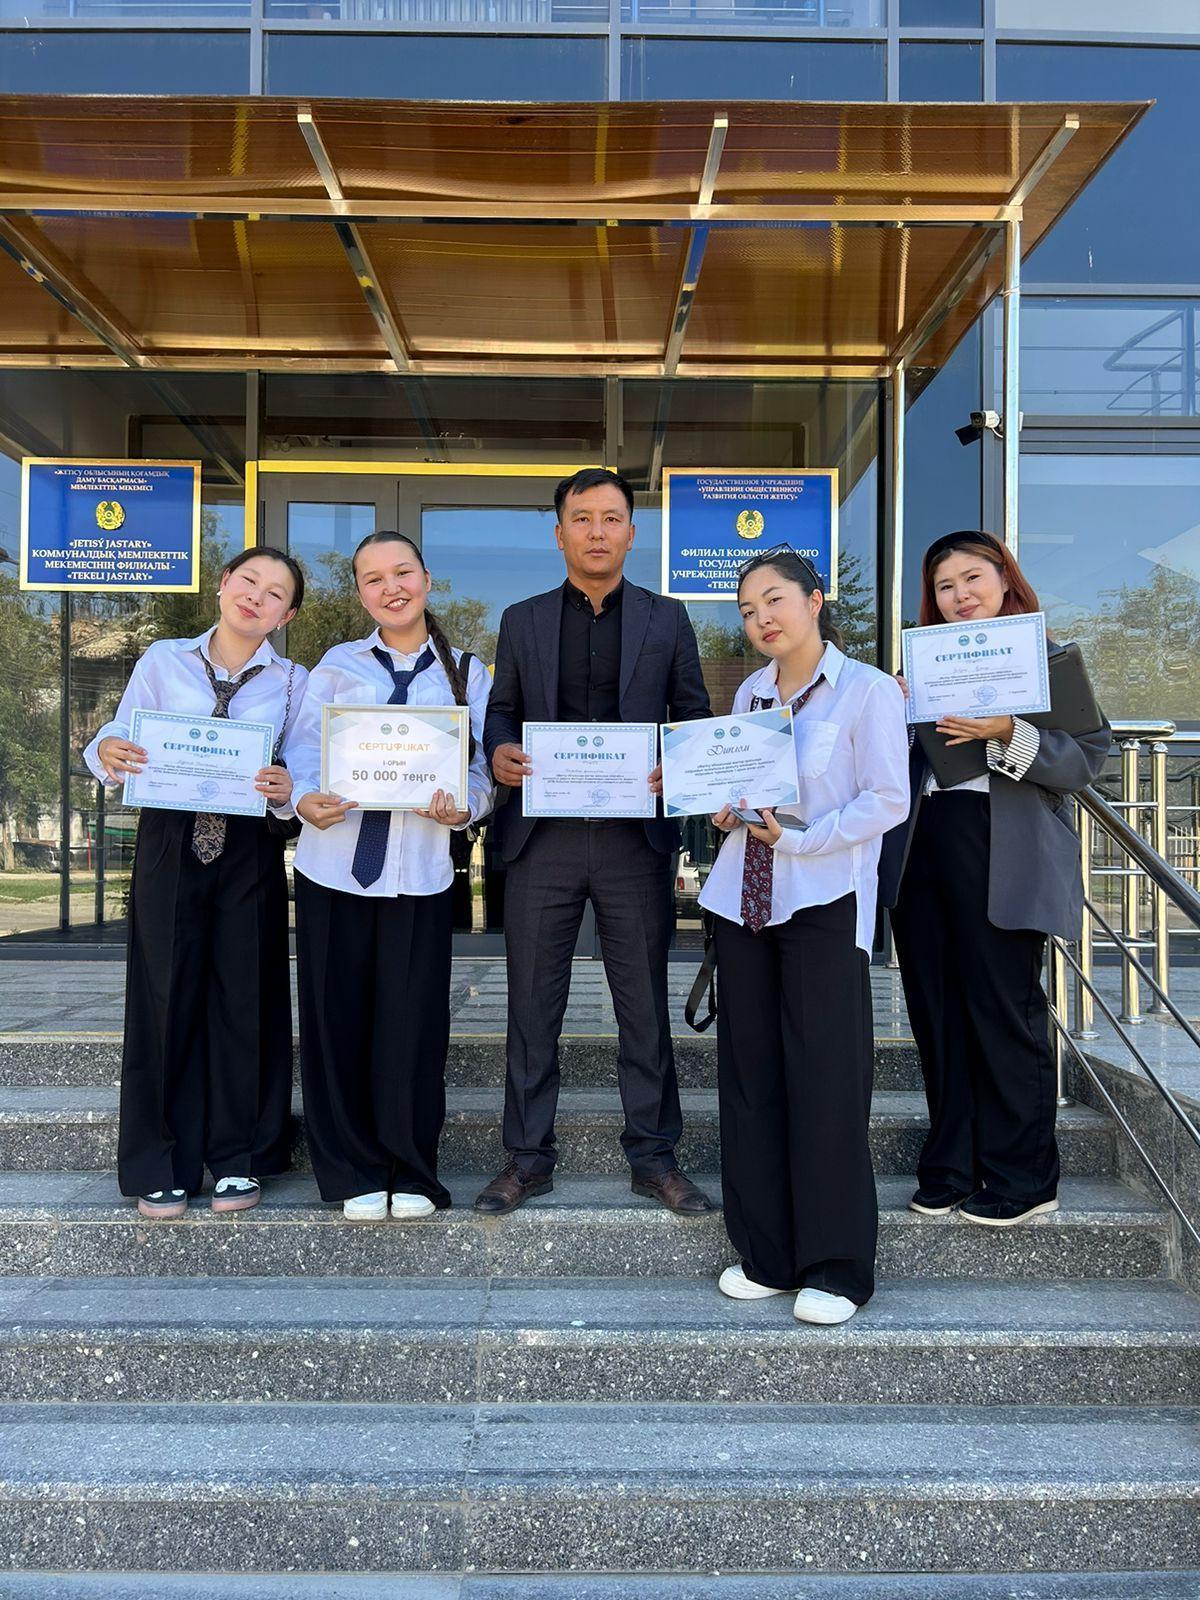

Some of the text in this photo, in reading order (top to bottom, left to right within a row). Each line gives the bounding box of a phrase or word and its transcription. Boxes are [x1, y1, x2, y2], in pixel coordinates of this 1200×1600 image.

[105, 540, 152, 548] JASTARY»
[32, 549, 189, 560] КОММУНАЛДЫҚ МЕМЛЕКЕТТІК
[681, 548, 820, 557] ФИЛИАЛ КОММУОГО
[45, 560, 115, 570] МЕКЕМЕСІНІҢ
[116, 561, 170, 570] ФИЛИАЛЫ
[67, 571, 153, 581] «TEKELI JASTARY»
[935, 647, 1014, 662] СЕРТИФИКАТ
[163, 742, 241, 756] СЕРТИФИКАТ
[358, 742, 430, 752] СЕРТИФИКАТ
[706, 744, 750, 757] Диплом
[553, 752, 627, 760] СЕРТИФИКАТ
[352, 770, 437, 783] 50 000 теңге
